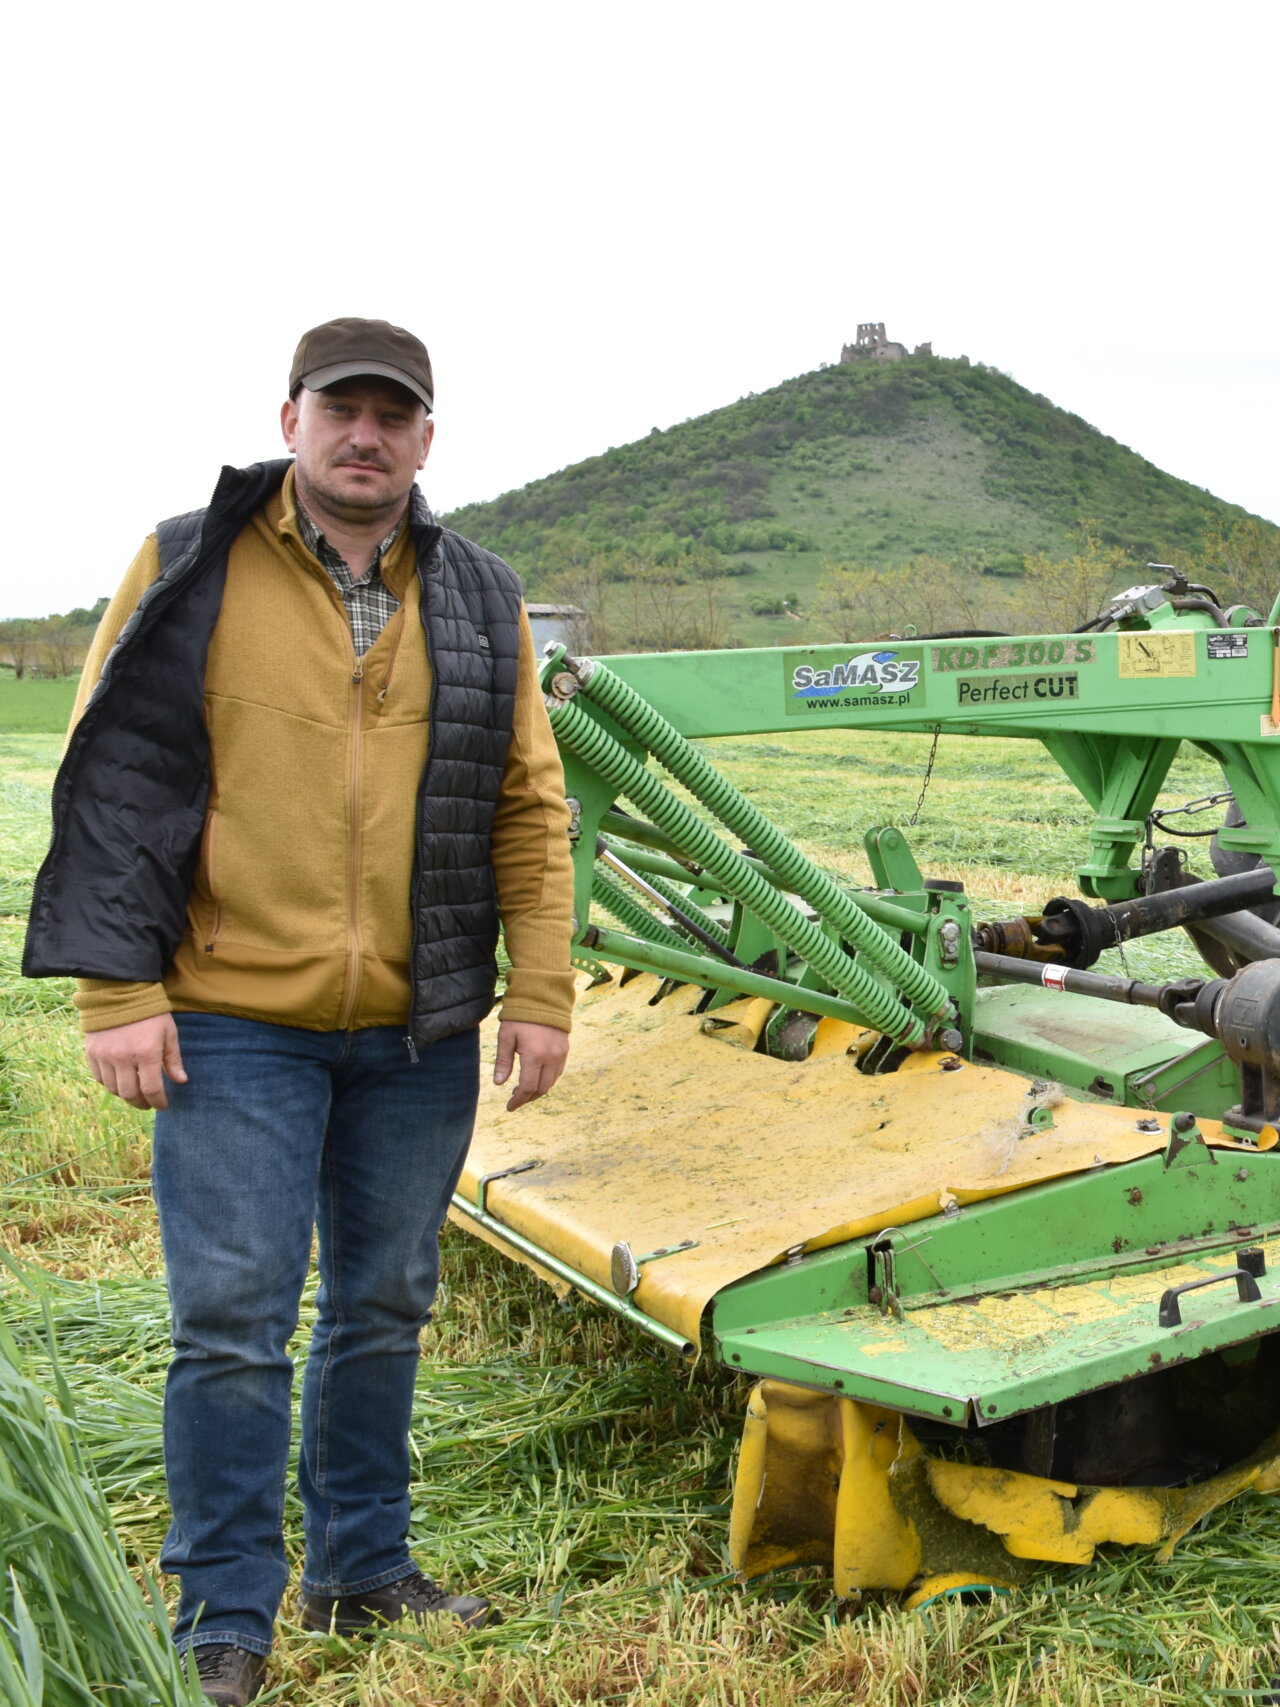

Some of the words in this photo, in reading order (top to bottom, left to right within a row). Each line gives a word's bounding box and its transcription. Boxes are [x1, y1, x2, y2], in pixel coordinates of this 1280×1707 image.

[936, 644, 1000, 672] KDF
[1008, 640, 1065, 667] 300
[1074, 639, 1093, 663] S
[793, 660, 919, 689] SaMASZ
[807, 692, 911, 709] www.samasz.pl
[959, 678, 1029, 703] Perfect
[1034, 676, 1078, 697] CUT
